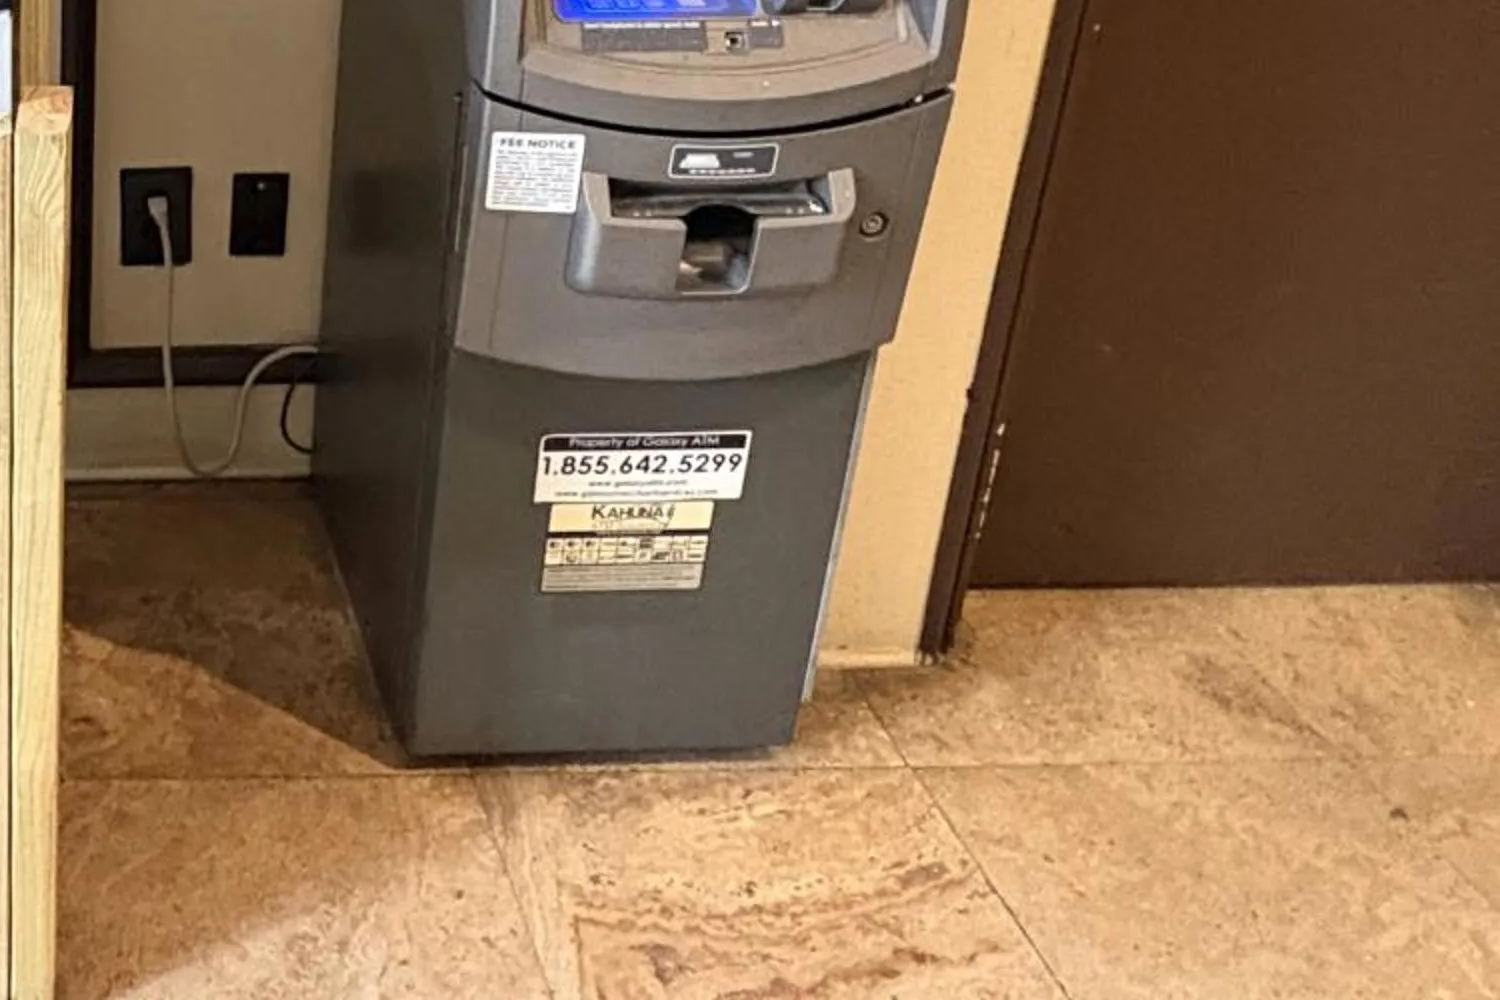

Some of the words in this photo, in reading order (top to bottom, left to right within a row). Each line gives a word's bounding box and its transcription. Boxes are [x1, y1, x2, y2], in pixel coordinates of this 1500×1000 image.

[499, 137, 524, 148] FEE
[527, 138, 577, 150] NOTICE
[568, 435, 624, 449] Property
[626, 435, 641, 447] of
[691, 433, 721, 446] ATM
[543, 452, 743, 476] 1.855.642.5299
